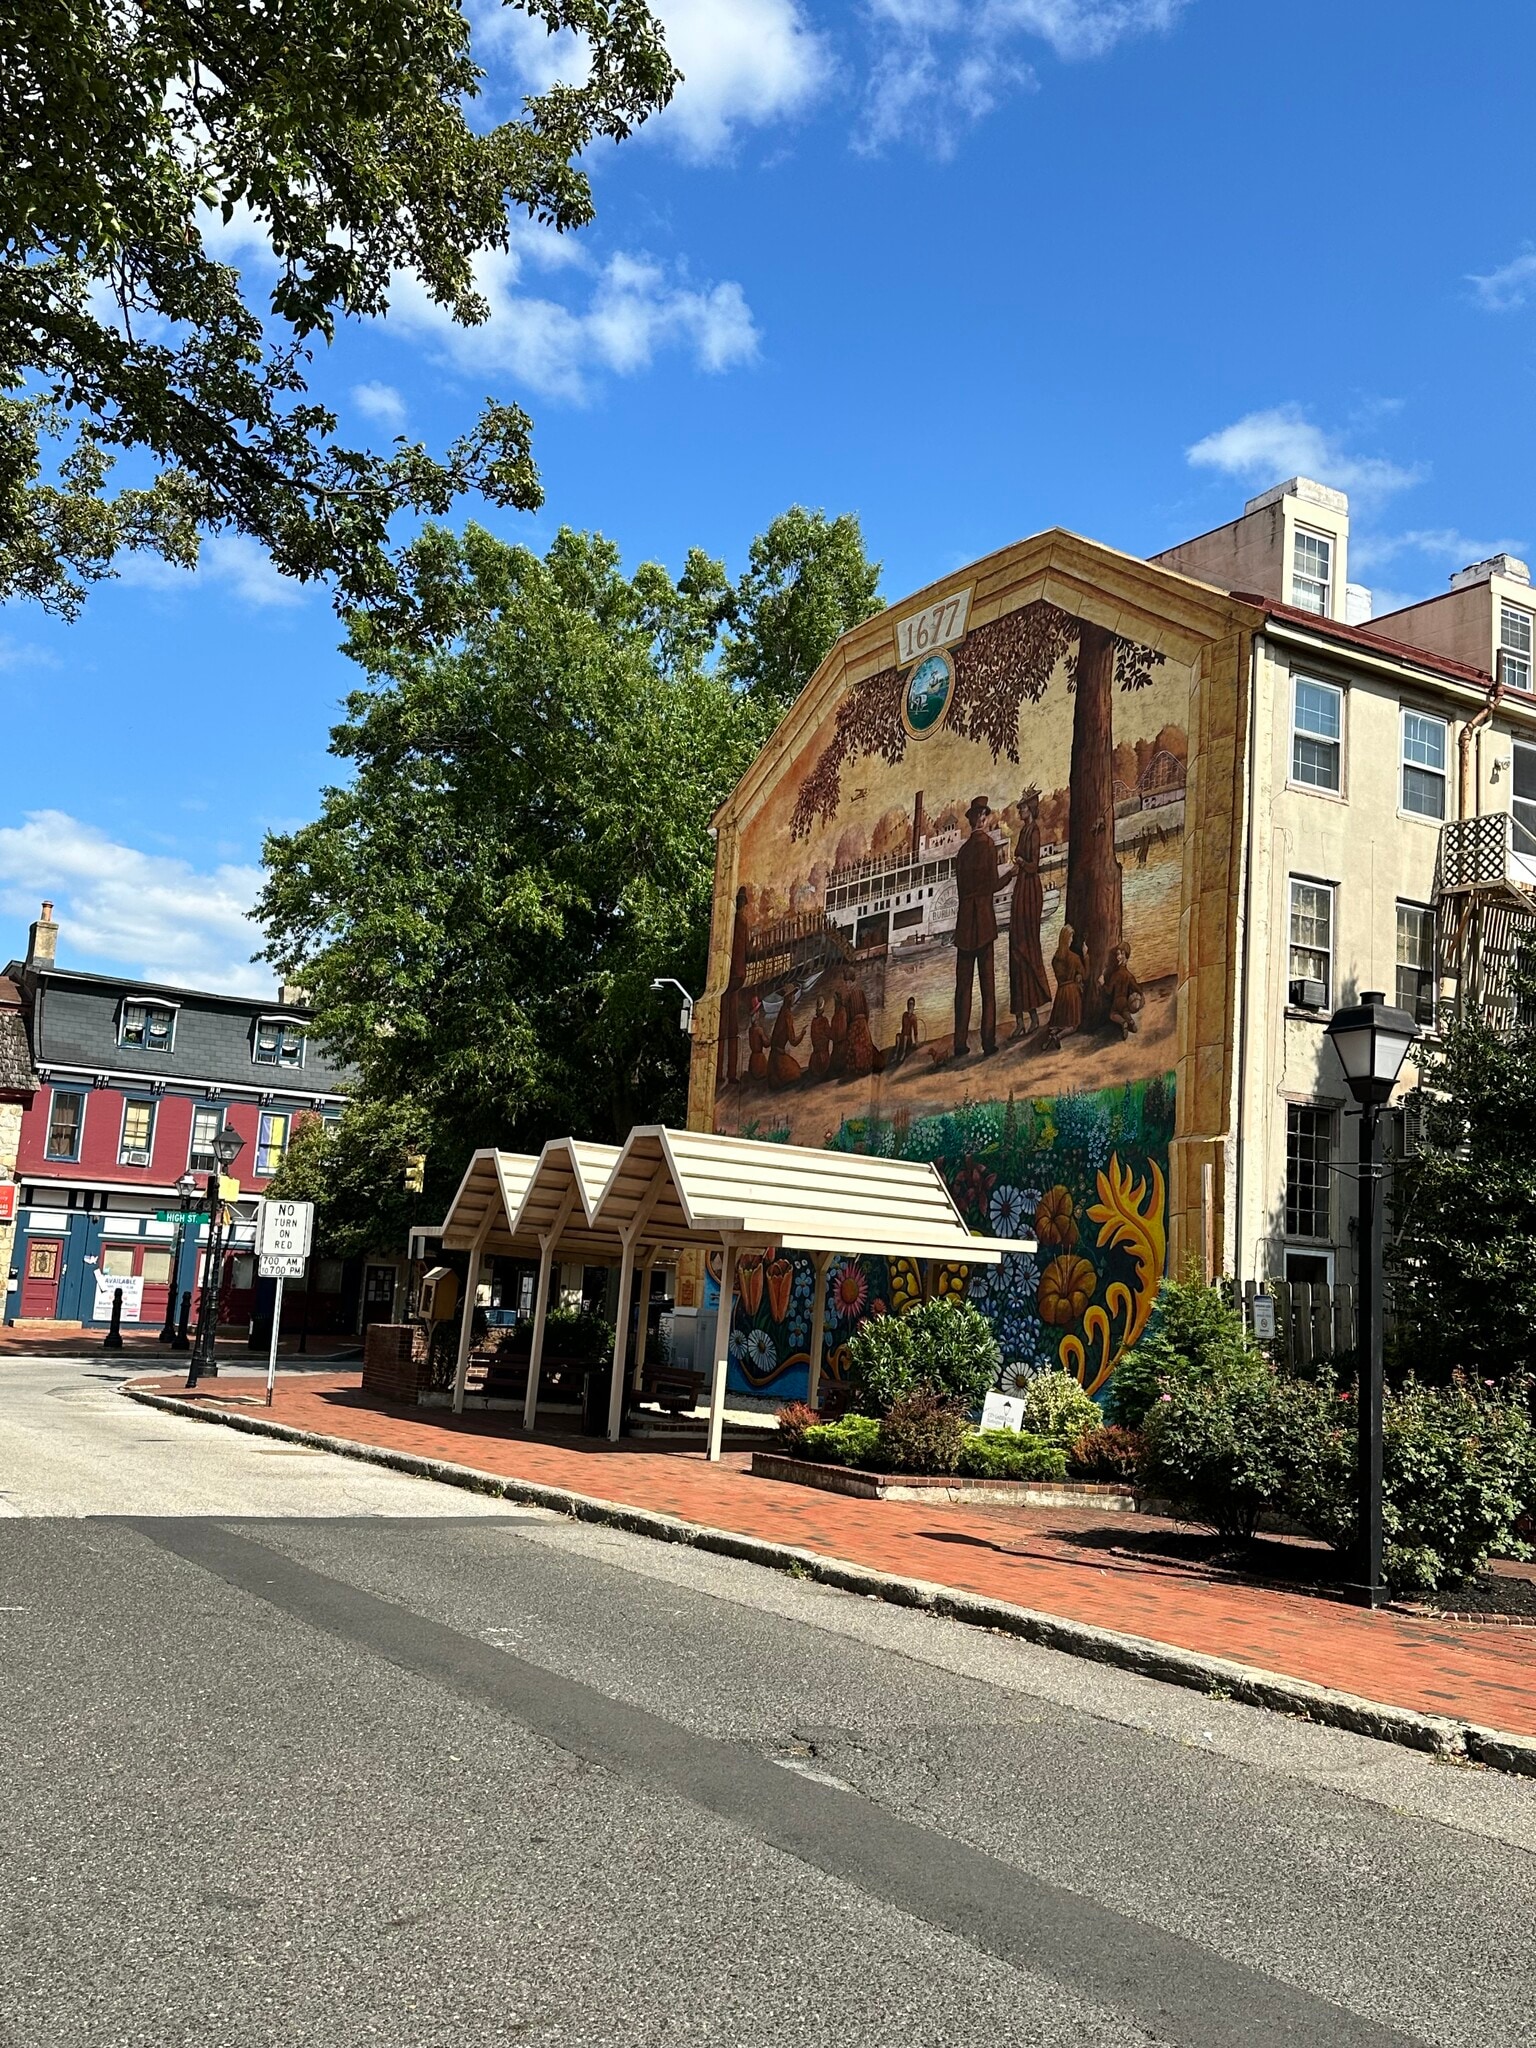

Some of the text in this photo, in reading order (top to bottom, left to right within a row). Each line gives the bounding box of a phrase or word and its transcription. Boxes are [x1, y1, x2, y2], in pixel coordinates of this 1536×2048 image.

[906, 598, 960, 657] 1677
[933, 907, 957, 920] BURLIN
[279, 1204, 295, 1216] NO
[166, 1213, 198, 1223] HIGH ST.
[274, 1218, 297, 1227] TURN
[279, 1229, 290, 1239] ON
[274, 1240, 293, 1250] RED
[286, 1257, 298, 1266] AM
[262, 1266, 268, 1274] TO
[105, 1278, 136, 1286] AVAILABLE
